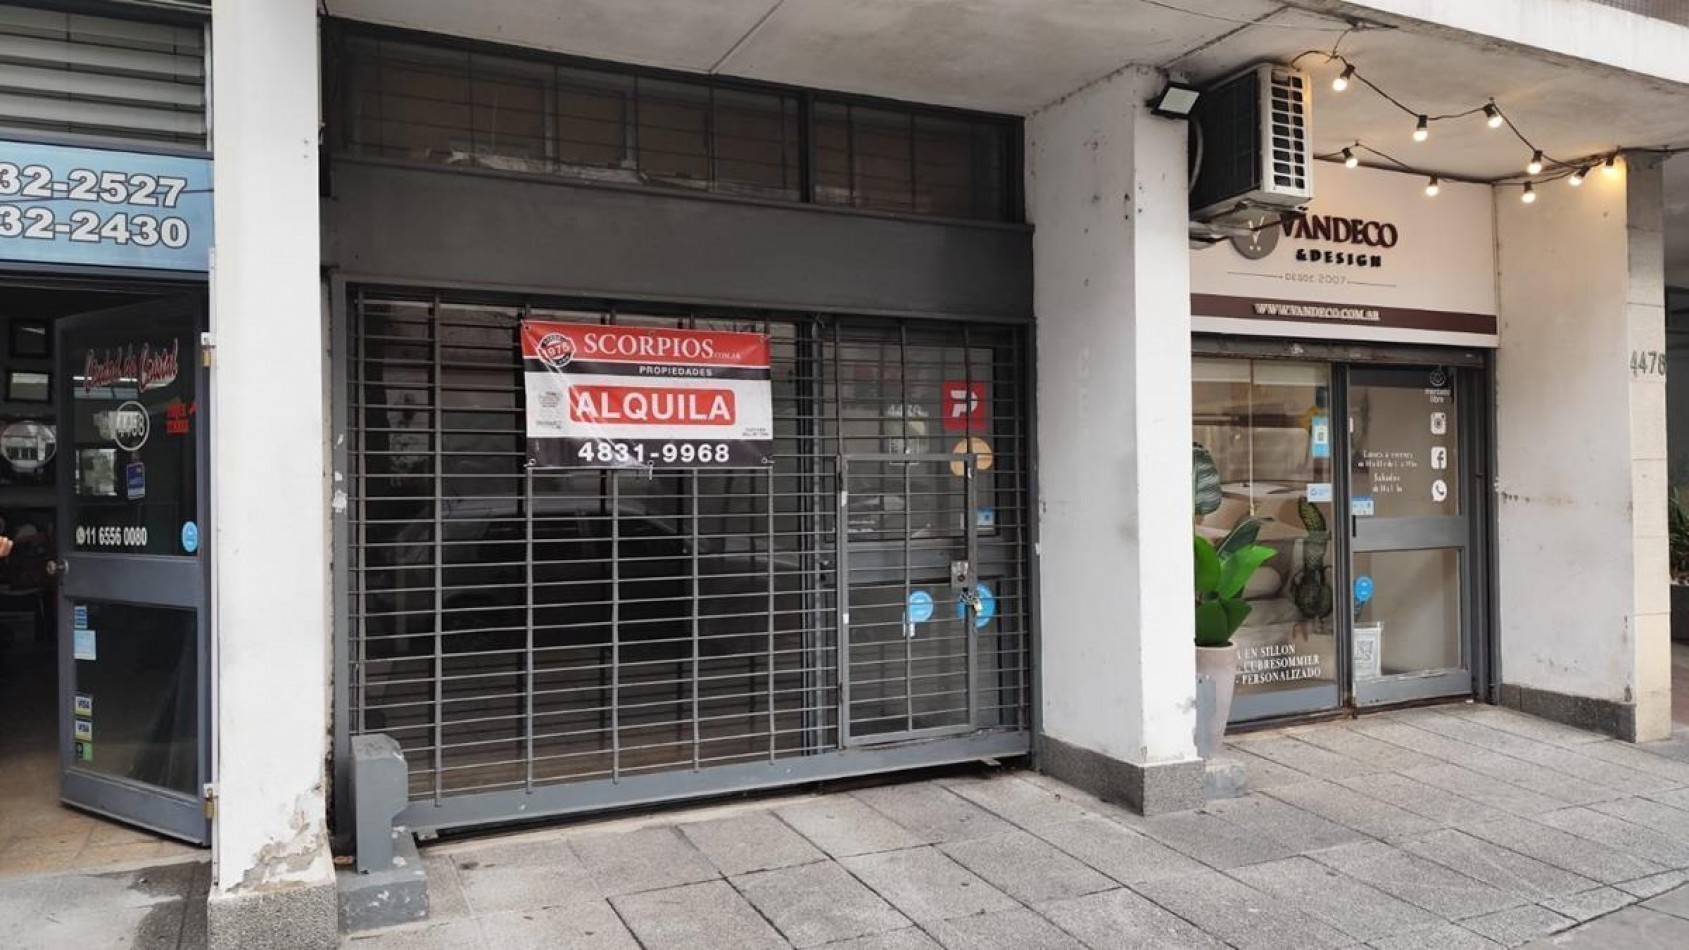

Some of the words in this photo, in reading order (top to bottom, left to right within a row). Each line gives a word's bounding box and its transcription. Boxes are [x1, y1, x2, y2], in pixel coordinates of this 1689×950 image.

[1284, 272, 1315, 283] DESDE
[1318, 273, 1348, 285] 2007
[1253, 303, 1380, 321] WWW.VANDECO.COM.AR
[583, 332, 714, 360] SCORPIOS
[638, 365, 713, 377] PROPIEDADES
[576, 391, 731, 421] ALQUILA
[577, 441, 730, 464] 4831-9968
[86, 526, 97, 545] 11
[99, 526, 121, 546] 6556
[124, 526, 148, 547] 0080
[1260, 643, 1296, 657] SILLON
[1243, 654, 1320, 673] CUBRESOMMIER
[1242, 667, 1321, 685] PERSONALIZADO
